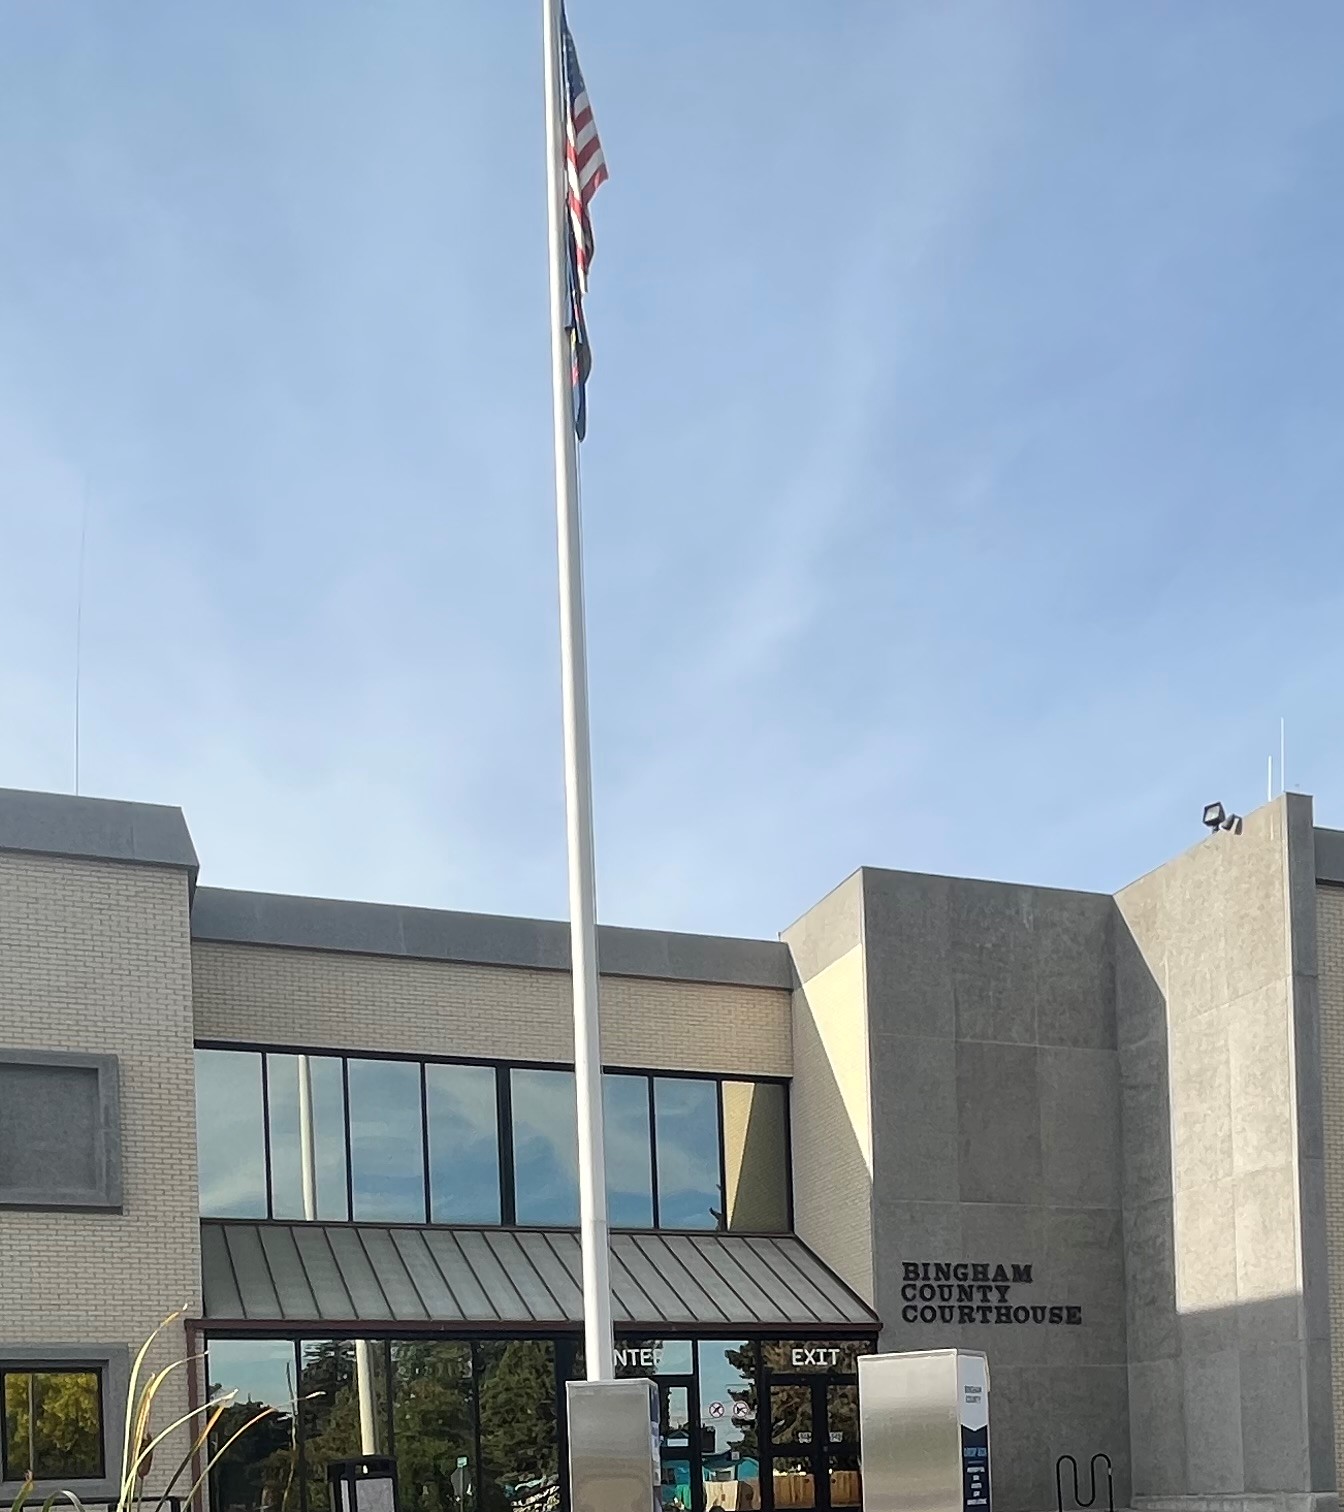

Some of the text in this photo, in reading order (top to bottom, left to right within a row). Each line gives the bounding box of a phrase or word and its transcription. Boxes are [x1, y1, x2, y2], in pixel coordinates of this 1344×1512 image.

[901, 1261, 1033, 1283] BINGHAM
[901, 1283, 1011, 1303] COUNTY
[901, 1304, 1082, 1325] COURTHOUSE
[613, 1348, 665, 1367] NTER
[792, 1348, 840, 1366] EXIT
